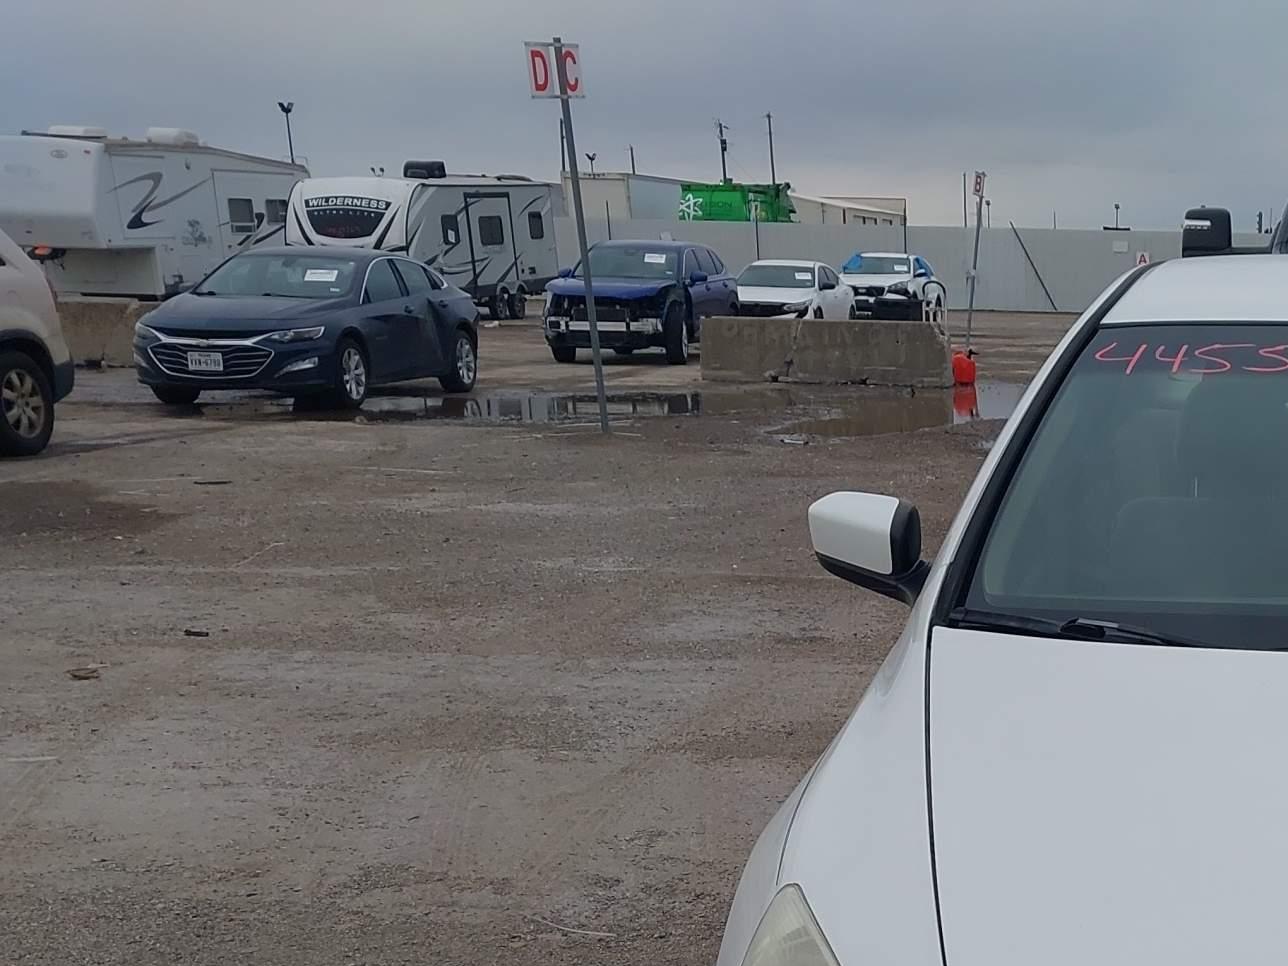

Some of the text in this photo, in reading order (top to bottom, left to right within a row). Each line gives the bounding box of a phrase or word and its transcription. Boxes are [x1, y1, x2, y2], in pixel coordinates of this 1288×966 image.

[530, 49, 579, 92] D C
[974, 175, 982, 193] B
[308, 197, 387, 209] WILDERNESS
[1138, 253, 1148, 265] A
